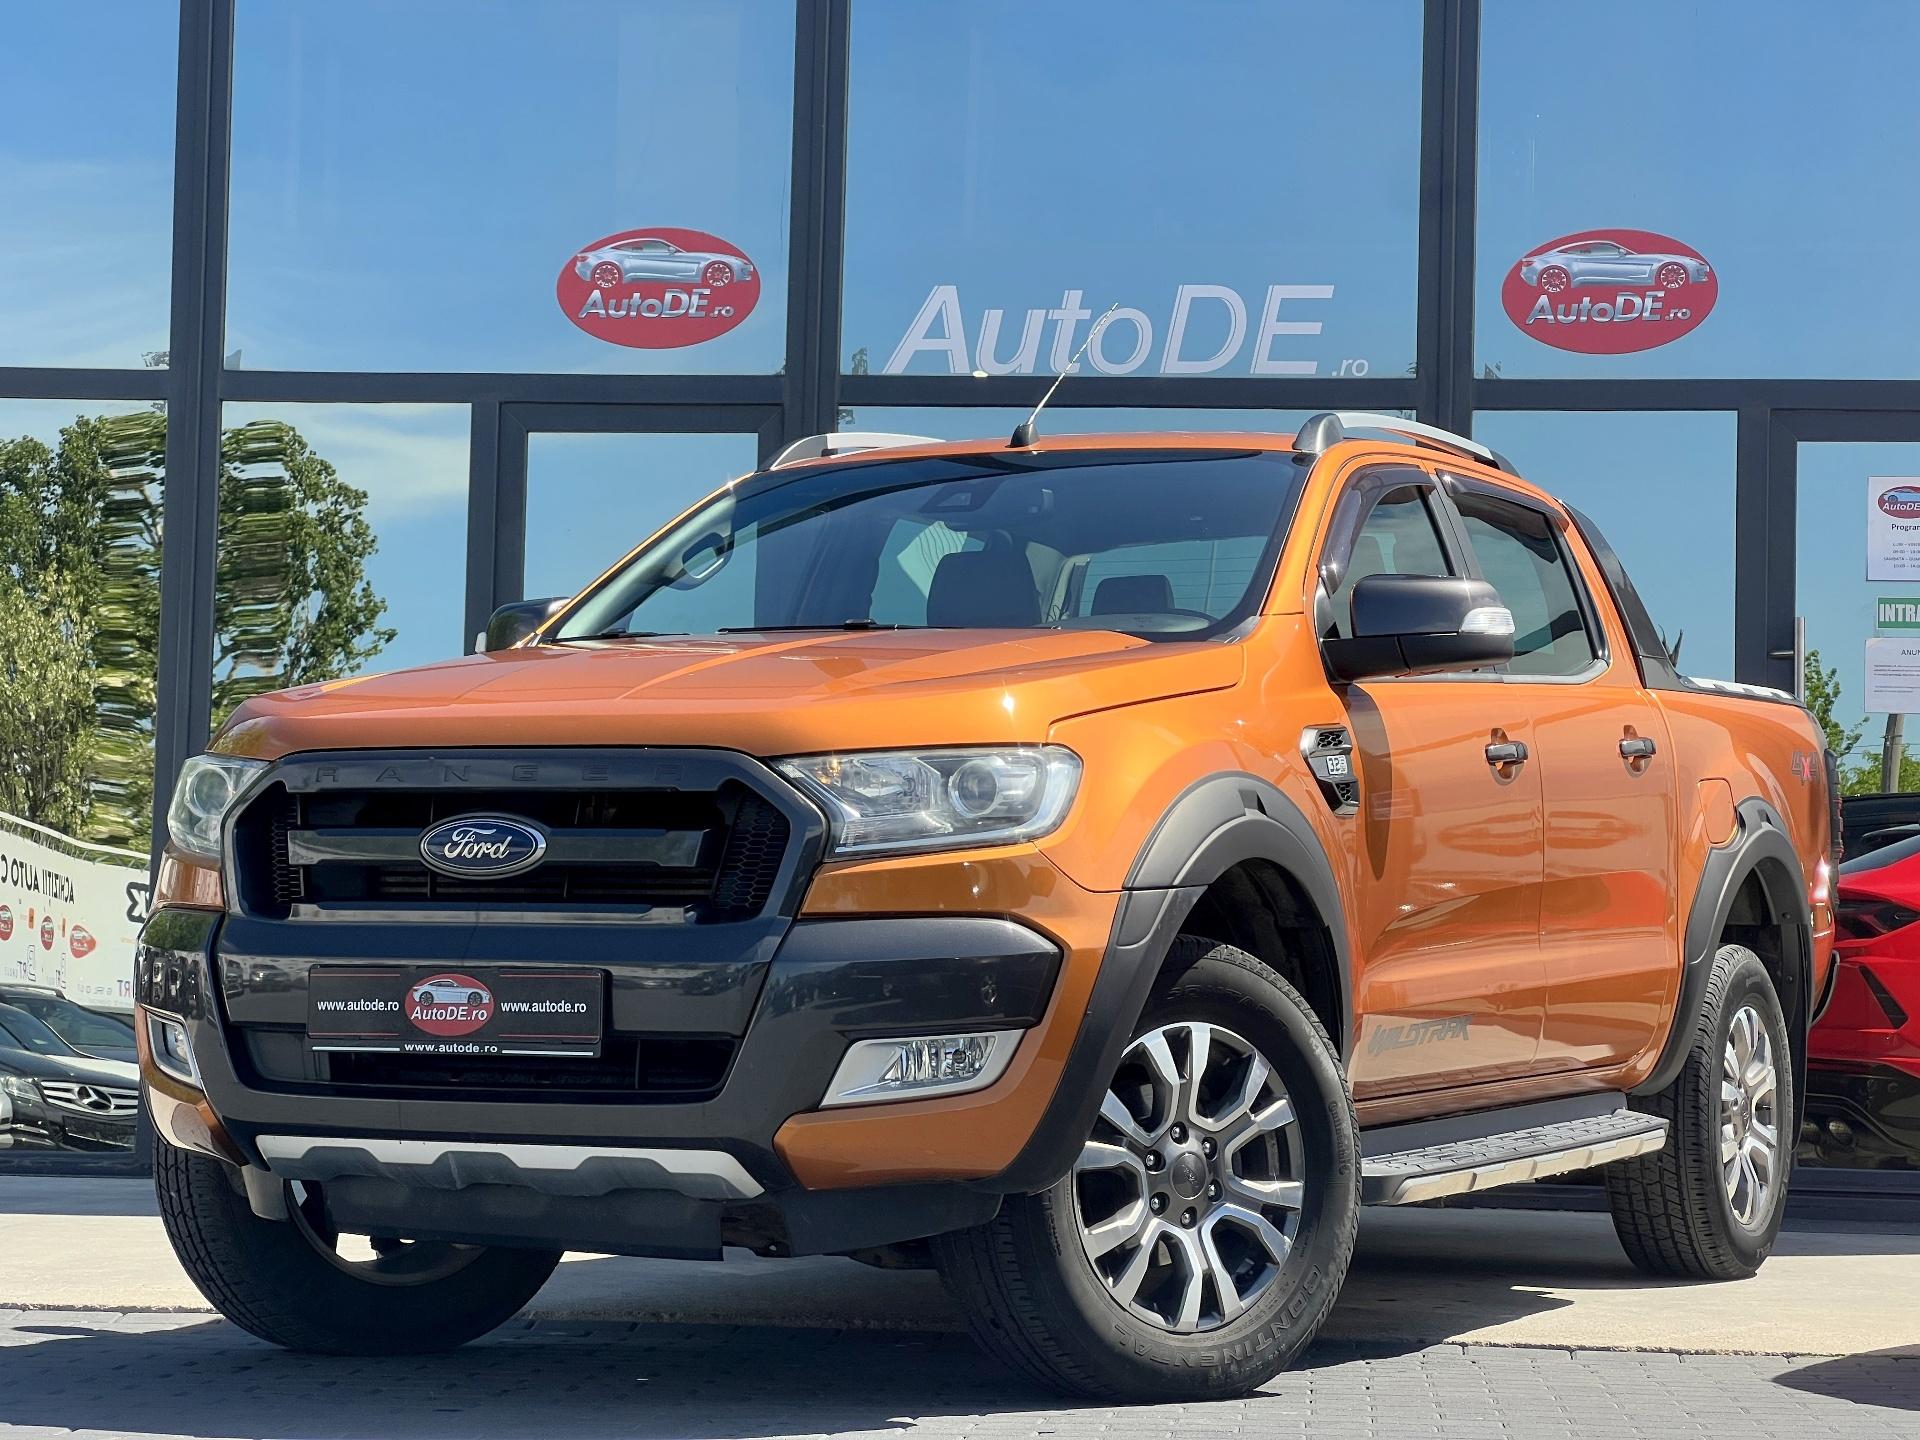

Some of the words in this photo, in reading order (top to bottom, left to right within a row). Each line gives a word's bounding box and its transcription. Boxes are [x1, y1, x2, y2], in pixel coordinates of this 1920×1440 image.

[315, 764, 682, 784] RANGER
[443, 826, 511, 860] Ford
[317, 998, 400, 1011] www.autode.ro
[500, 1000, 587, 1013] www.autode.ro
[410, 1005, 488, 1022] AutoDE.ro
[1369, 1014, 1474, 1056] WILDTRAK
[404, 1042, 498, 1054] www.autode.ro
